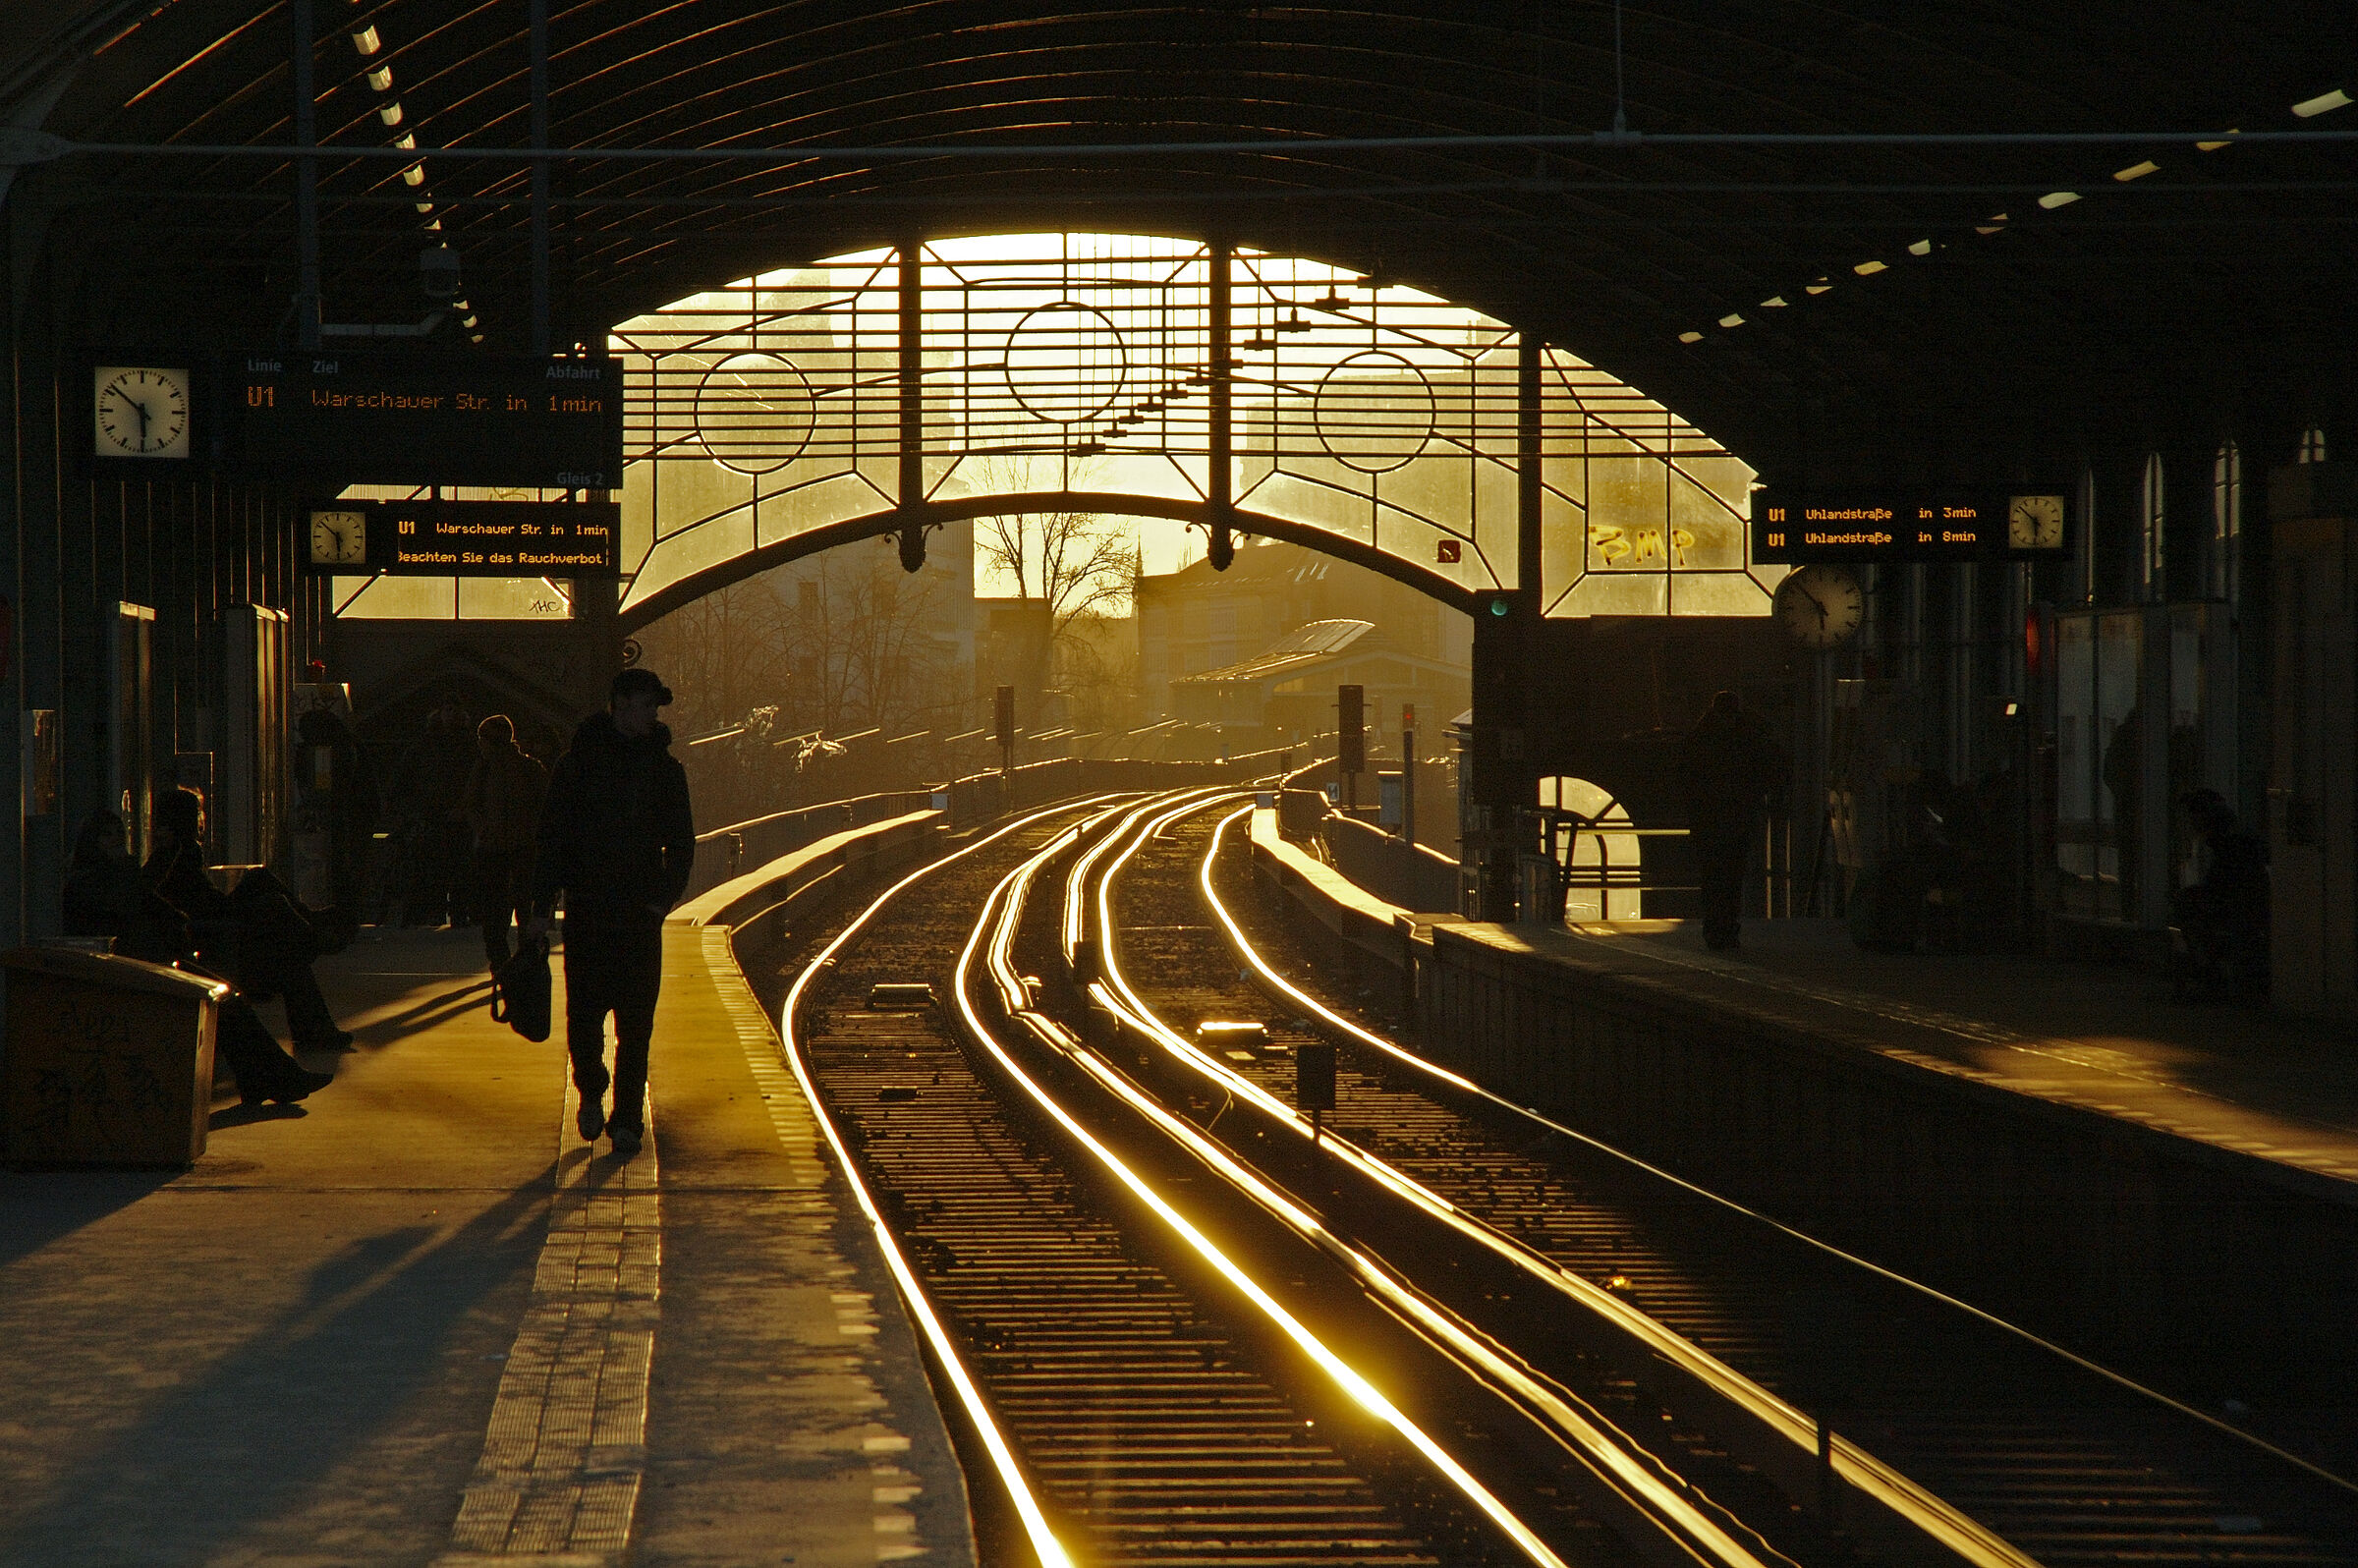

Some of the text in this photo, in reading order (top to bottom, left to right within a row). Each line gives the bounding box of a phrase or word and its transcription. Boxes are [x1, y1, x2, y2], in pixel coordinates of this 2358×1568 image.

[248, 360, 283, 372] Linie
[312, 361, 339, 374] Ziel
[545, 364, 600, 379] Abfahrt
[248, 385, 274, 408] U1
[310, 389, 445, 409] Warschauer
[456, 392, 490, 410] Str.
[506, 394, 527, 412] in
[556, 472, 604, 485] Gleis 2
[1768, 507, 1977, 523] U1 Uhlandstraße in 3min
[398, 521, 416, 535] U1
[435, 522, 515, 535] Warschauer
[521, 523, 542, 535] Str.
[550, 524, 565, 535] in
[1768, 531, 1976, 547] U1 Uhlandstraße in 8min
[462, 552, 484, 564] Sie
[489, 552, 513, 564] das
[519, 552, 603, 565] Rauchverbot
